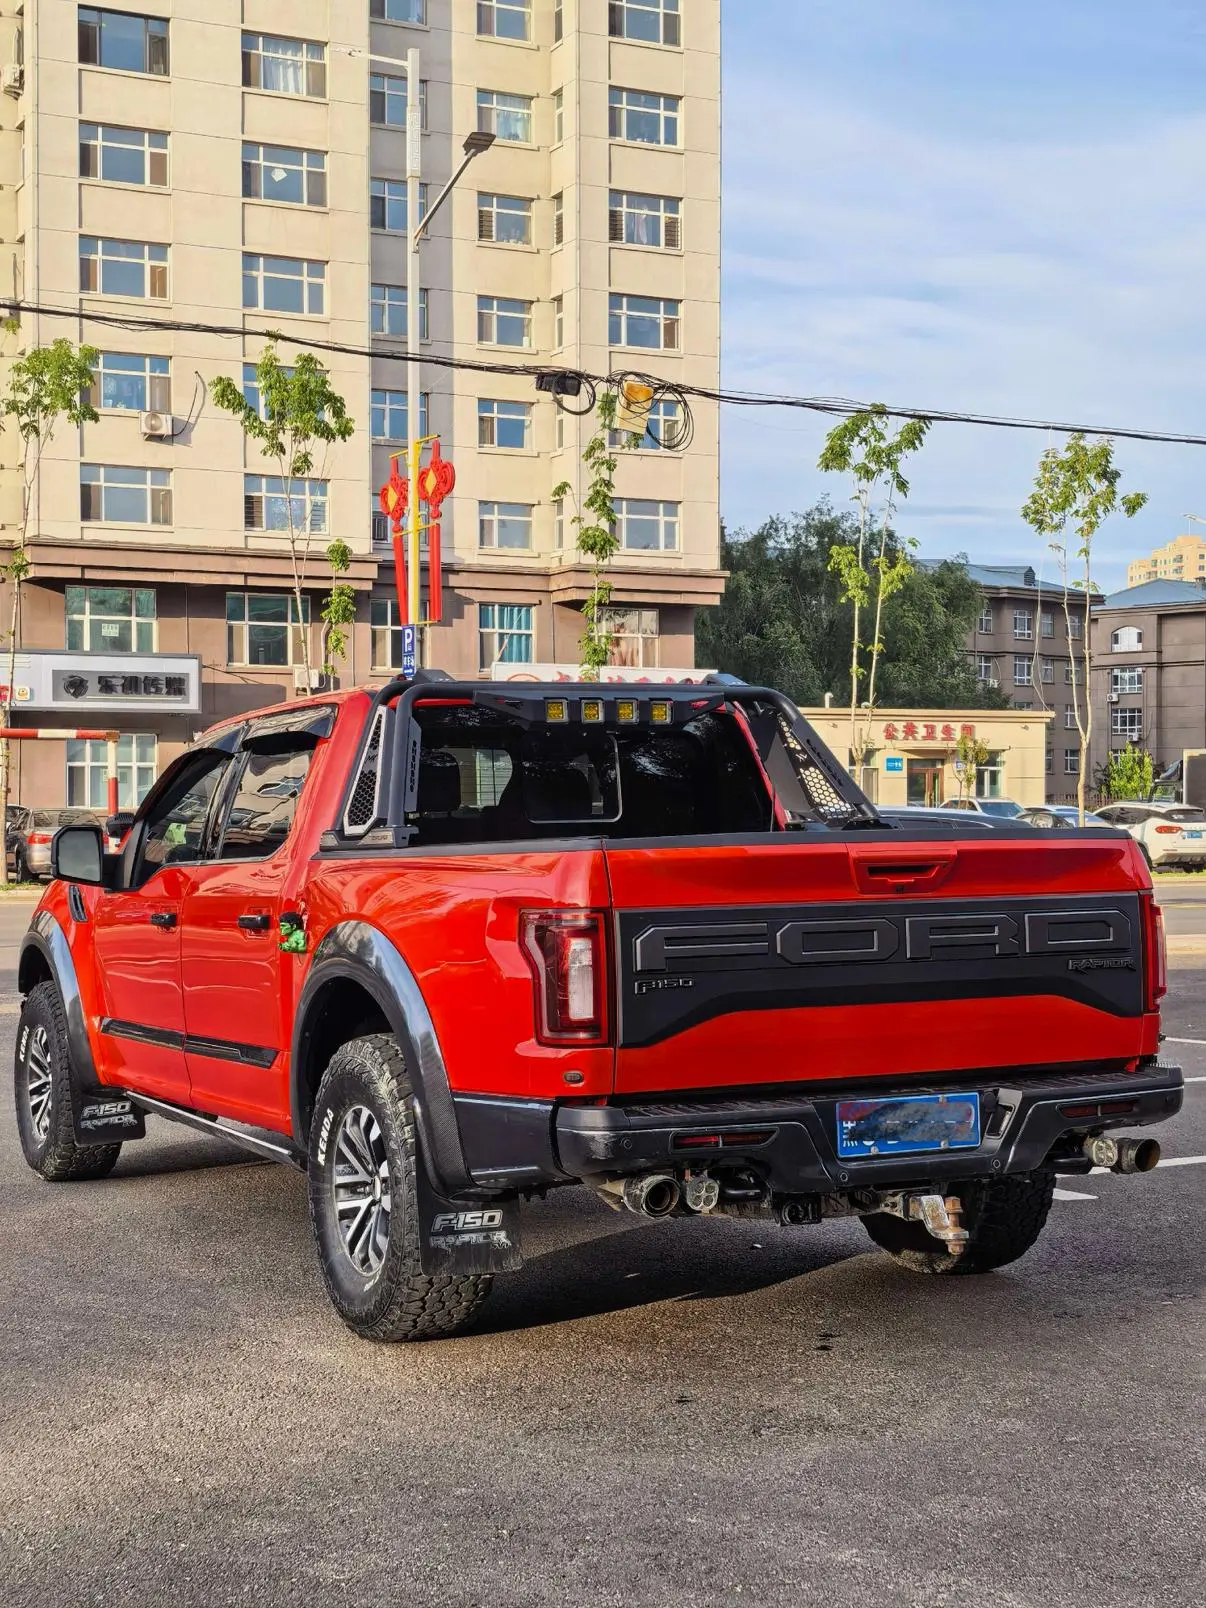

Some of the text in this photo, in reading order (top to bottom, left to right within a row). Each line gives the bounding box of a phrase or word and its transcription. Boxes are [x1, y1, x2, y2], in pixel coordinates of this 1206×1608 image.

[404, 628, 413, 652] P
[883, 720, 976, 741] 公共卫生间
[632, 908, 1131, 973] FORD
[1067, 957, 1136, 975] RAPTOR
[317, 1108, 334, 1166] KENDA
[431, 1210, 503, 1232] F-150
